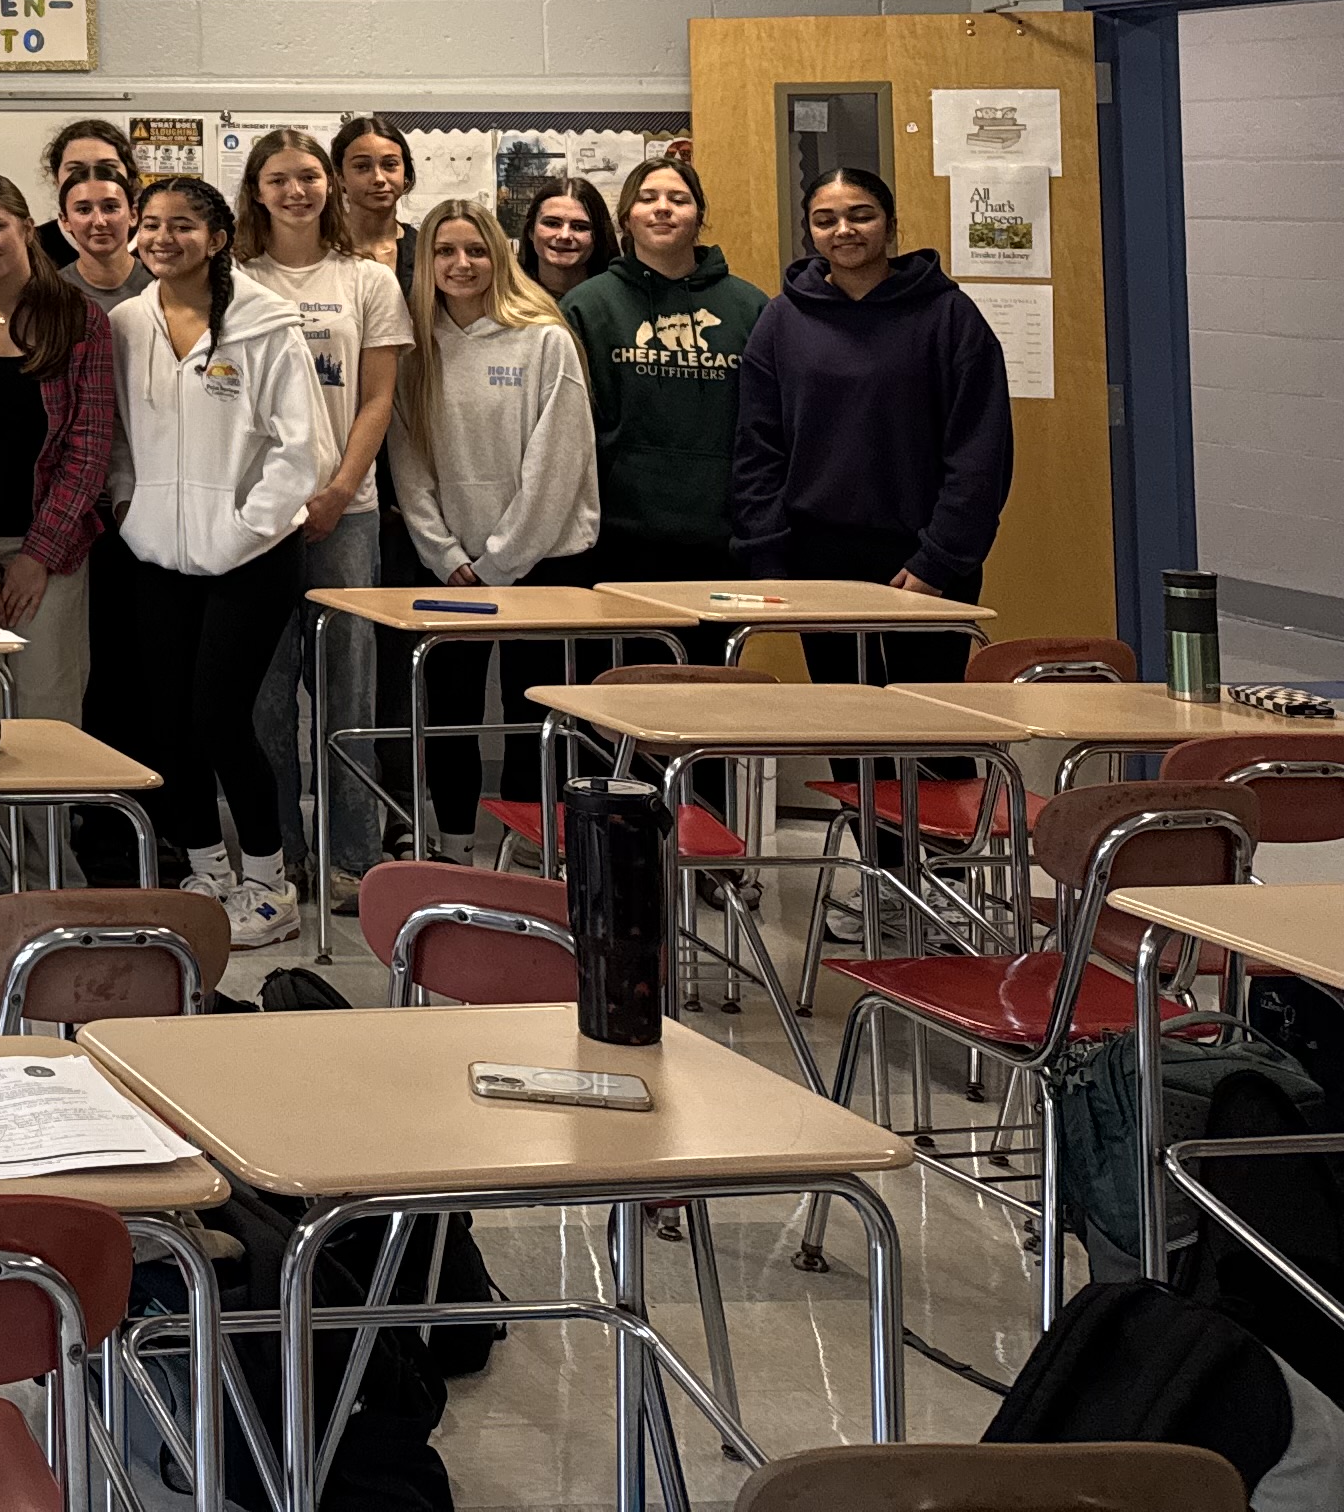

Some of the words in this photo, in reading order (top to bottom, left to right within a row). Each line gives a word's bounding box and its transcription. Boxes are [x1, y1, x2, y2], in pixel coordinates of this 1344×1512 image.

[970, 187, 990, 203] All
[972, 199, 1015, 213] That's
[970, 211, 1023, 225] Unseen
[612, 347, 672, 364] CHEFF
[635, 364, 726, 380] OUTFITTERS
